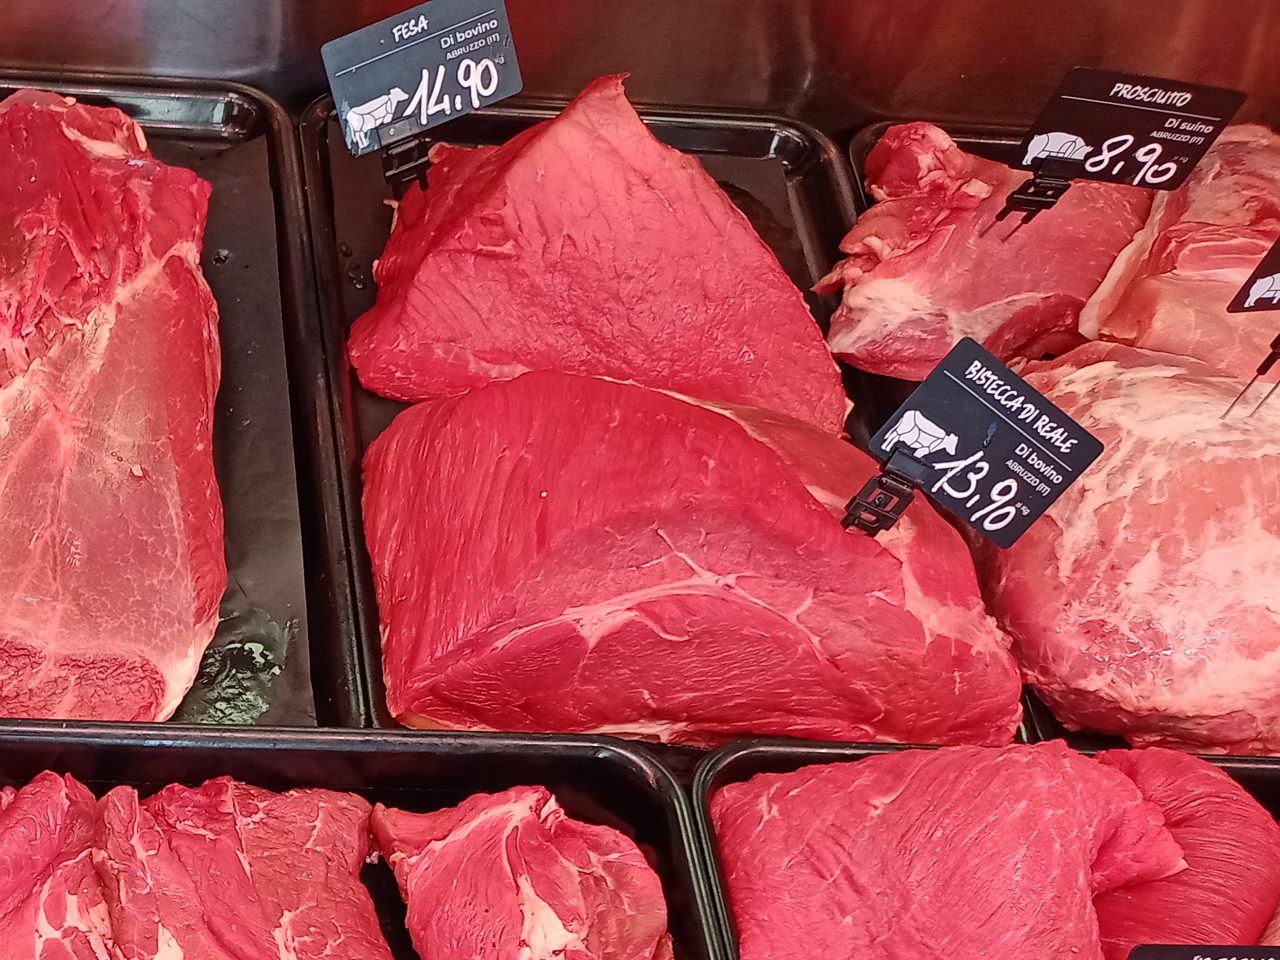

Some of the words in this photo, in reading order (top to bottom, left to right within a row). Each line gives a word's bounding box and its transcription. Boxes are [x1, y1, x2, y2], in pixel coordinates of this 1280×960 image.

[392, 14, 429, 43] FESA
[440, 34, 455, 49] Di
[456, 19, 498, 44] bovino
[446, 40, 486, 60] ABRUZZO
[487, 32, 500, 46] (IT)
[1109, 82, 1193, 107] PROSCIUTTO
[1150, 130, 1190, 142] ABRUZZO
[1164, 118, 1180, 129] Di
[1180, 120, 1214, 134] suino
[965, 360, 1022, 412] BISTECCA
[1018, 402, 1038, 424] DI
[1033, 415, 1078, 454] REALE
[1006, 458, 1039, 488] ABRUZZO
[1036, 479, 1051, 496] (IT)
[1015, 442, 1030, 460] Di
[1028, 450, 1062, 485] bovino
